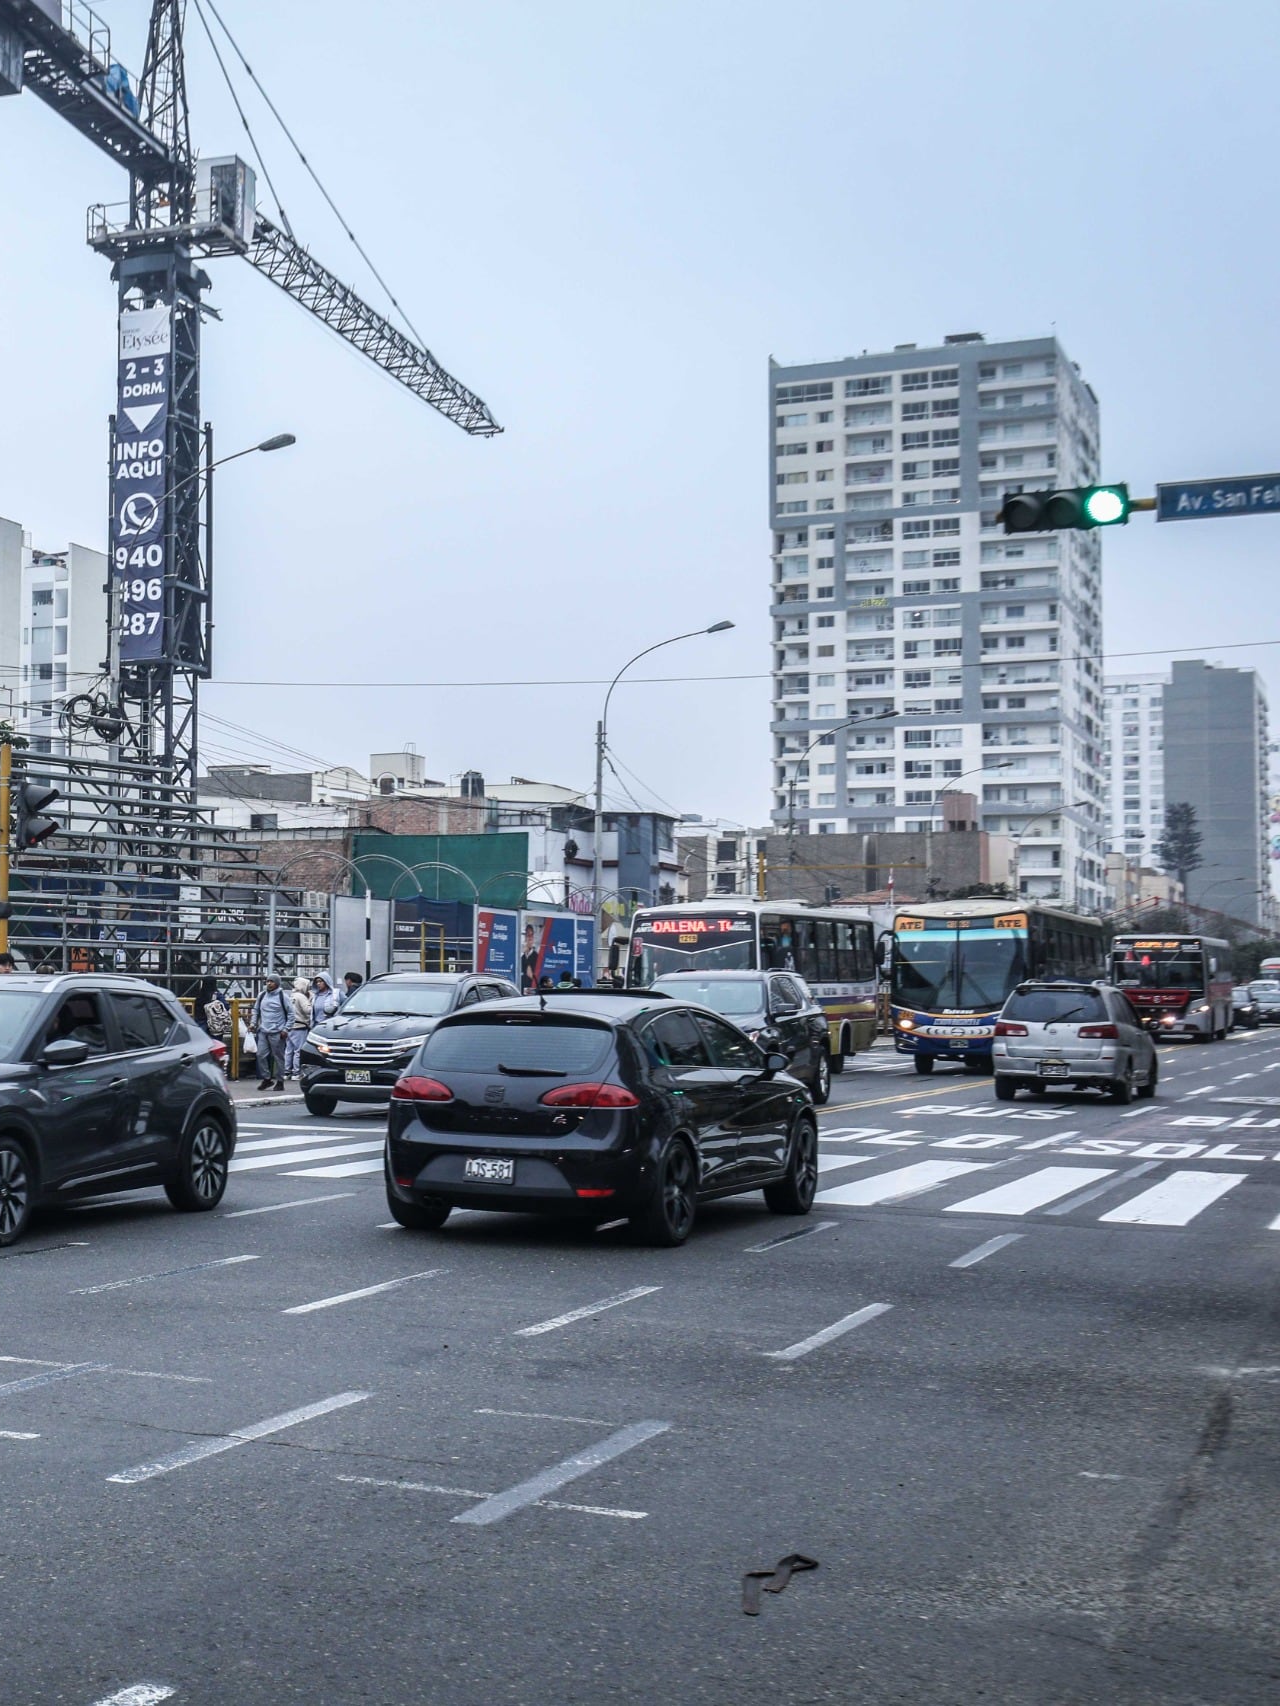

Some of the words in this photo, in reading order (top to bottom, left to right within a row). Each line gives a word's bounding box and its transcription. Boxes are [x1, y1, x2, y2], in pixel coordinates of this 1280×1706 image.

[125, 362, 137, 380] 2
[153, 358, 165, 376] 3
[122, 381, 166, 398] DORM.
[117, 438, 164, 461] INFO
[116, 459, 162, 480] AQUI
[1176, 492, 1208, 512] Av.
[1212, 489, 1247, 509] San
[115, 544, 163, 570] 940
[899, 921, 922, 930] ATE
[996, 919, 1022, 928] ATE
[892, 1104, 1078, 1120] BUS
[817, 1126, 1024, 1149] OLO
[1056, 1139, 1280, 1161] SOL
